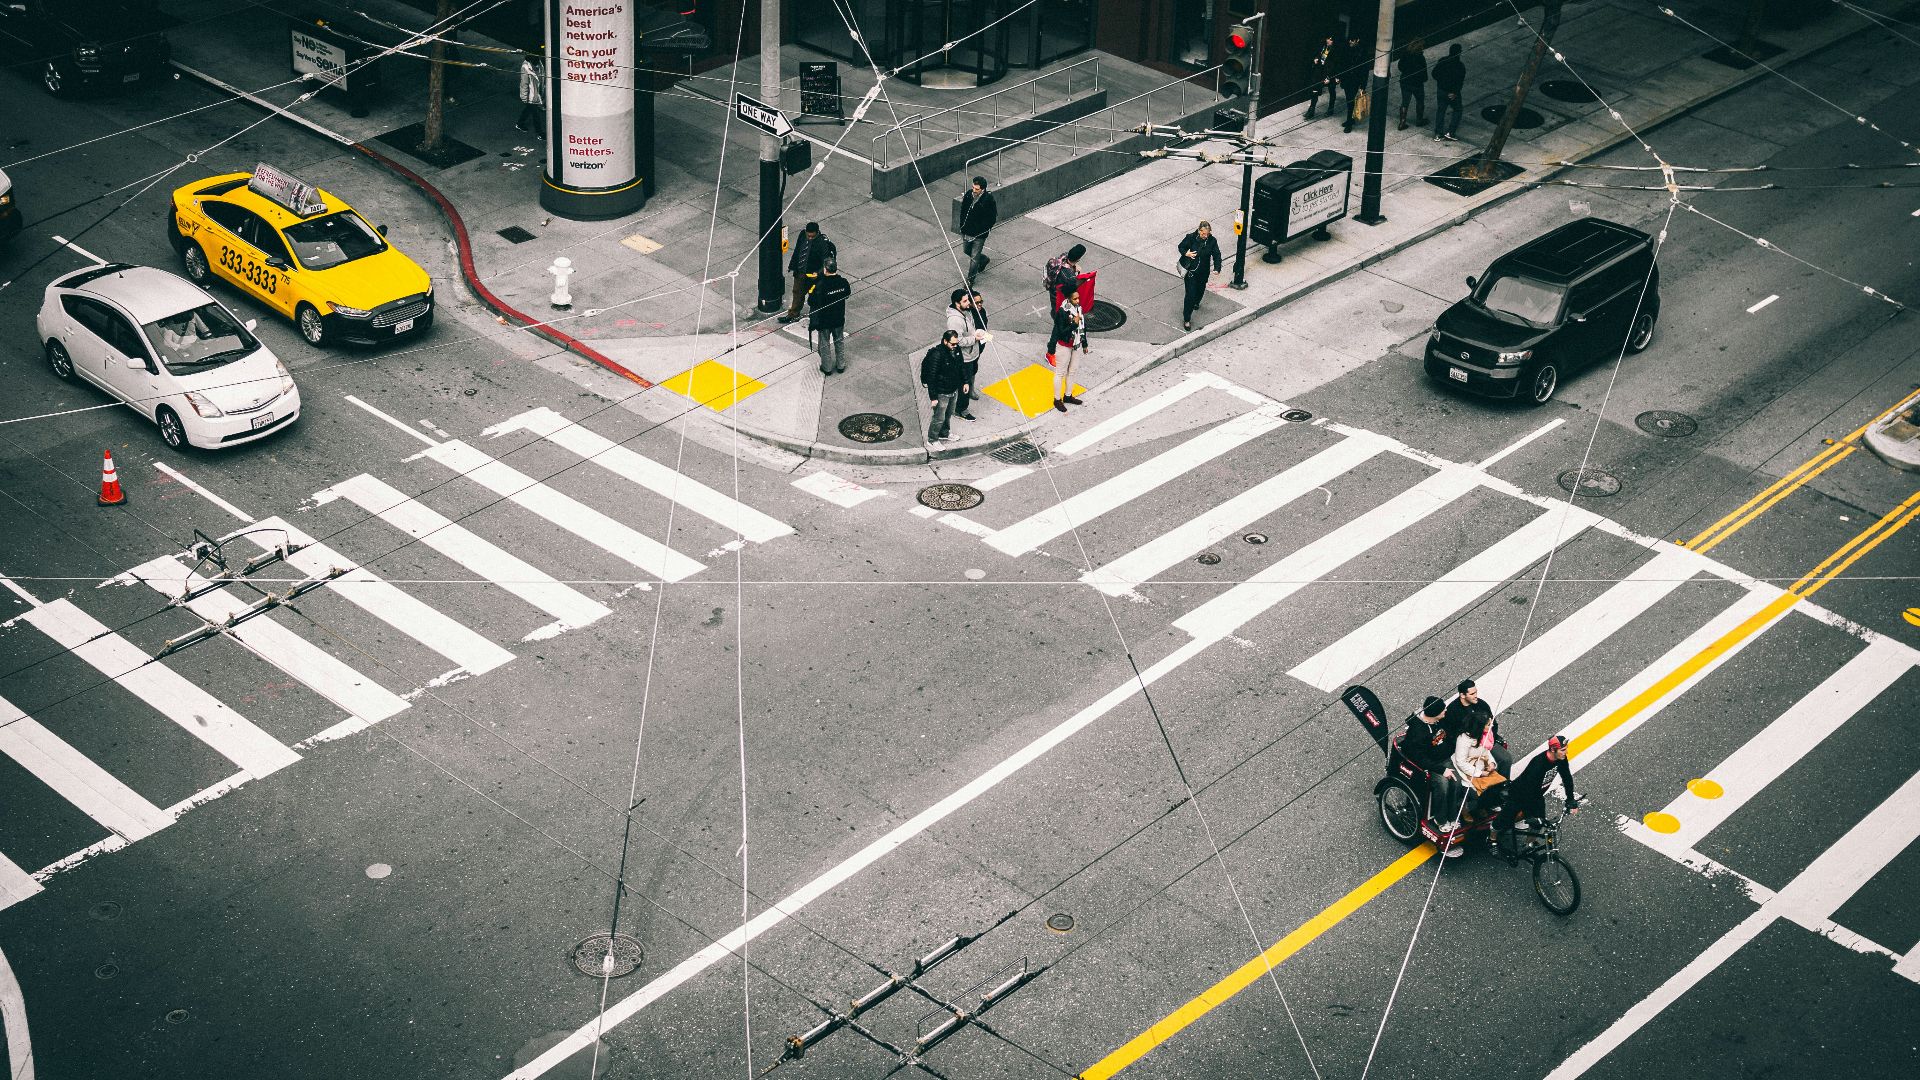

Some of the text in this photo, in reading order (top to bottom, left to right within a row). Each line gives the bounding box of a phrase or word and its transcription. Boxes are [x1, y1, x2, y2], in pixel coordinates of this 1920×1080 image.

[566, 4, 623, 16] America's
[566, 17, 592, 29] best
[566, 30, 618, 41] network.
[566, 46, 617, 58] Can your
[567, 58, 615, 69] network
[567, 69, 619, 82] say that?
[742, 105, 776, 127] ONE WAY
[568, 134, 603, 145] Better
[569, 147, 614, 156] matters.
[569, 160, 603, 170] verizon
[255, 172, 266, 182] FOR
[1303, 184, 1333, 202] Click Here
[310, 204, 322, 212] TAXI
[219, 245, 277, 295] 333-3333
[280, 273, 291, 285] 775
[1354, 693, 1369, 708] FREE
